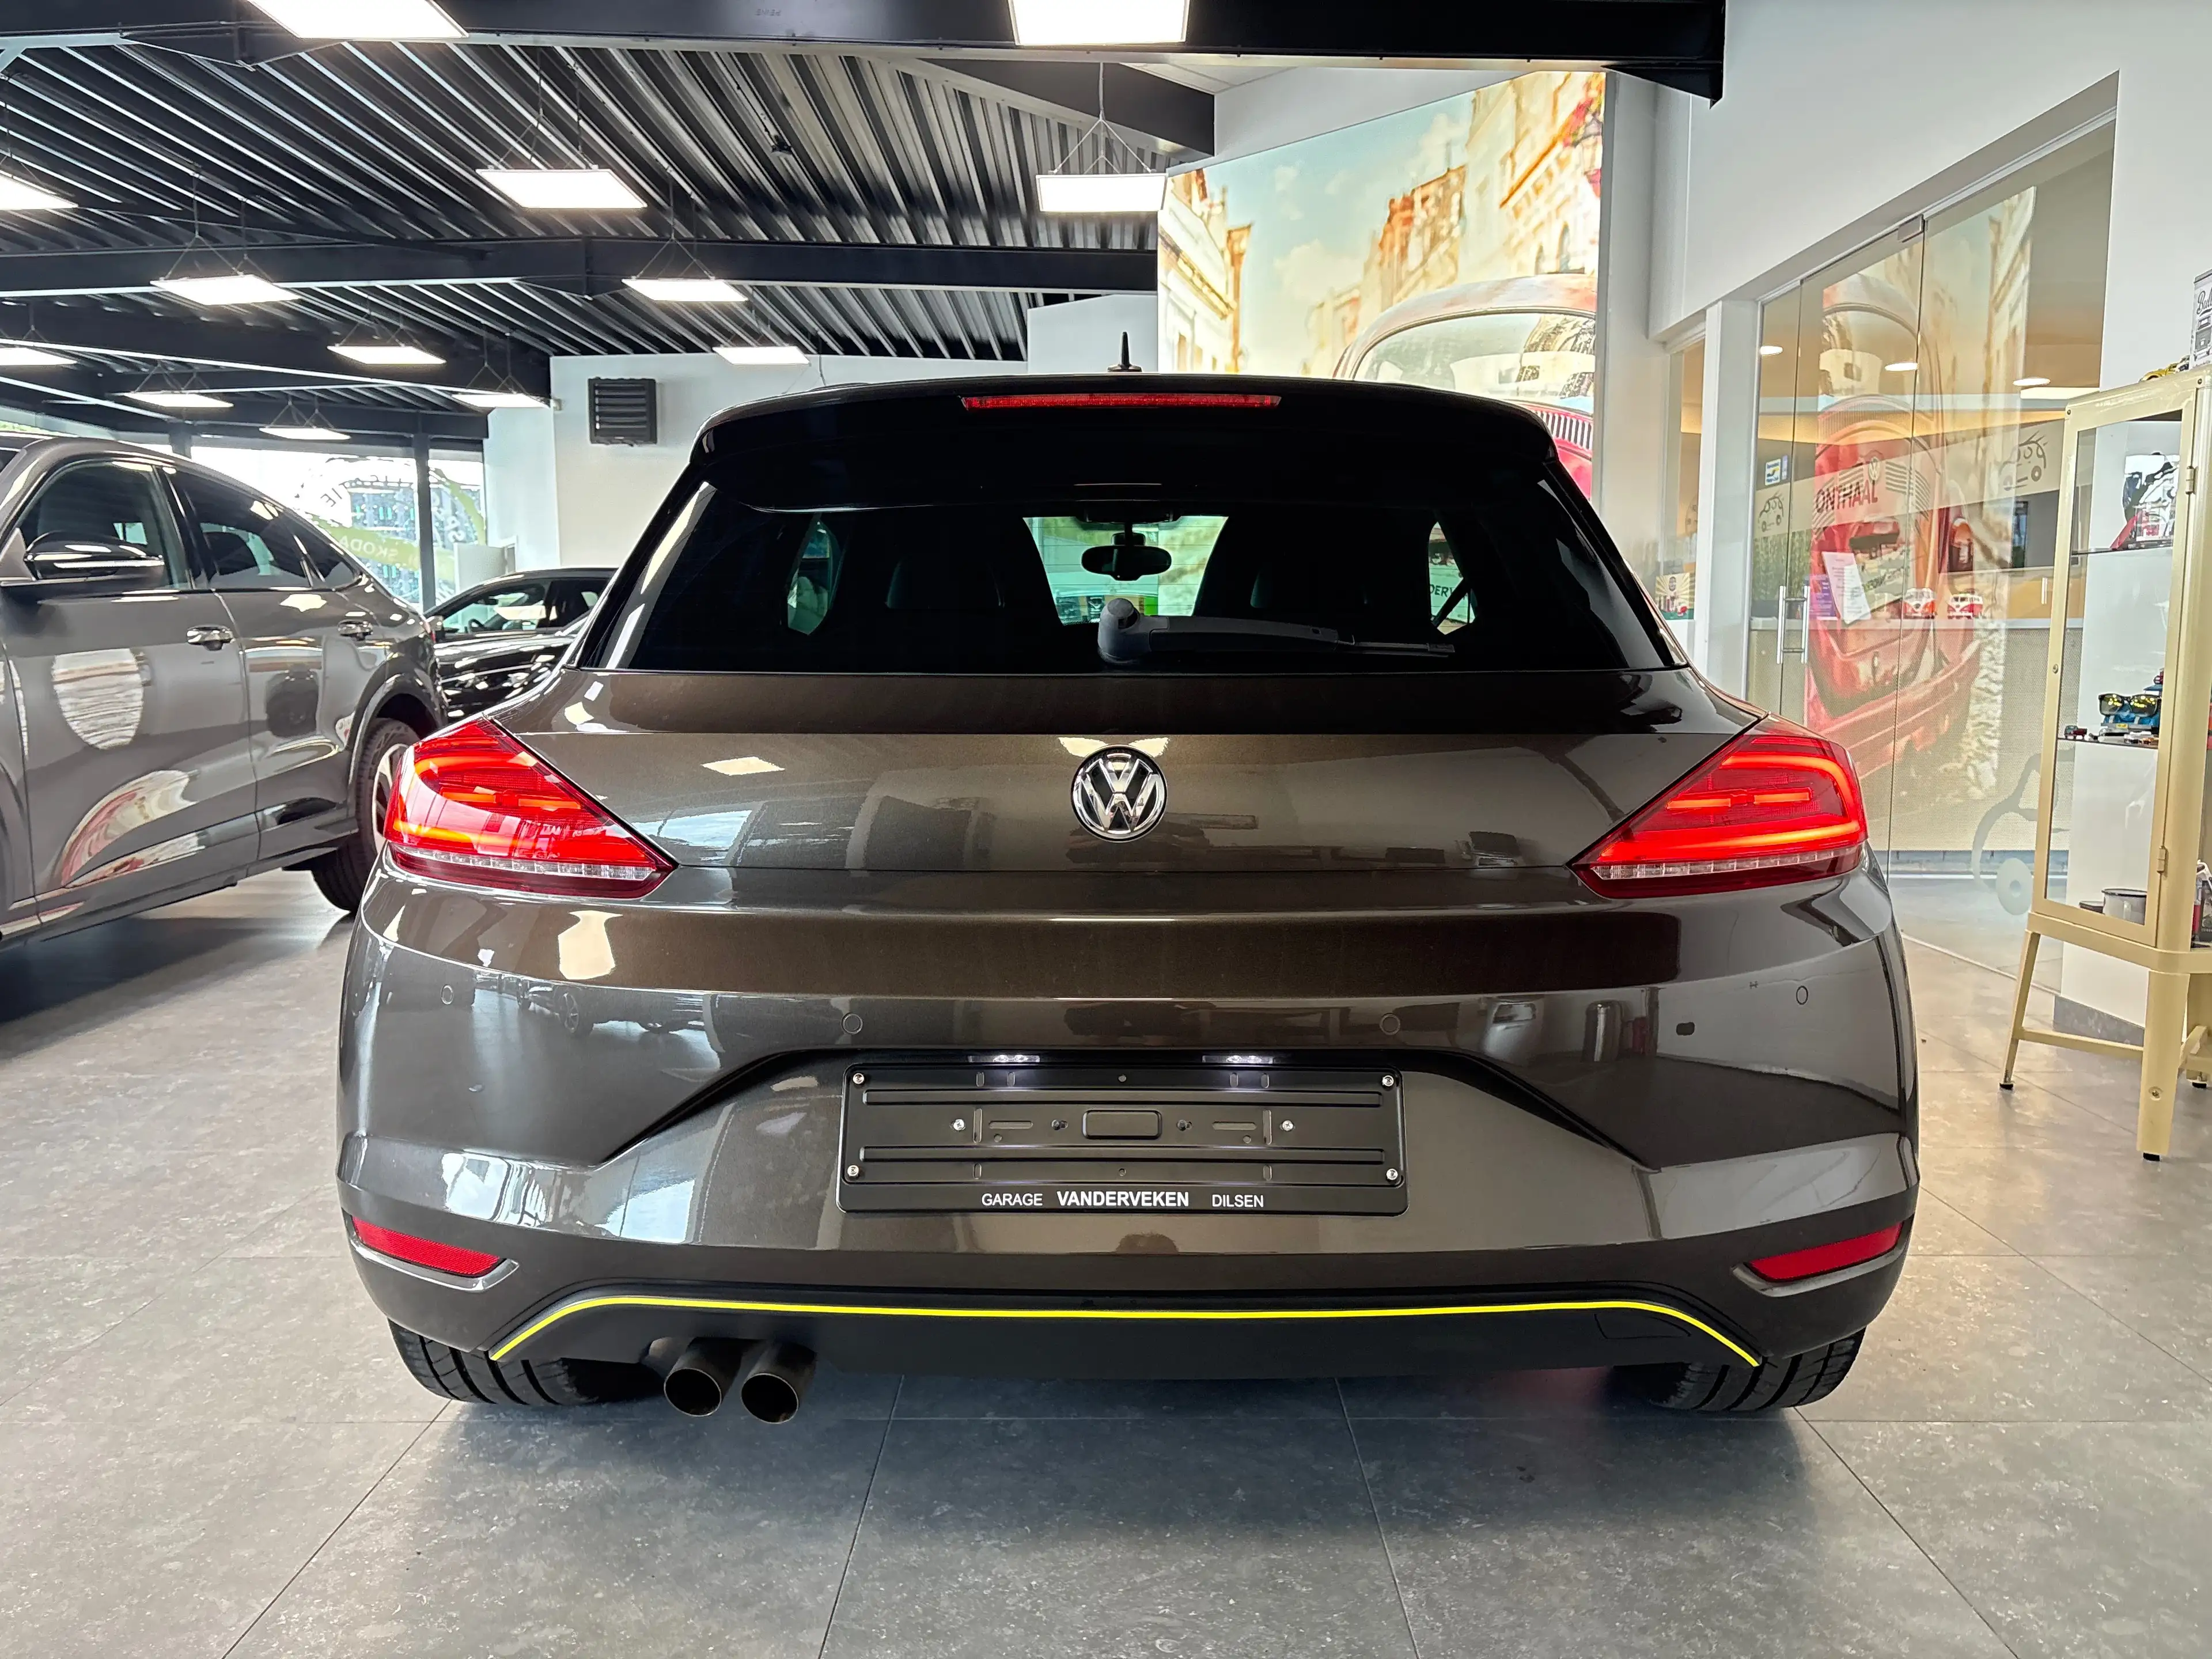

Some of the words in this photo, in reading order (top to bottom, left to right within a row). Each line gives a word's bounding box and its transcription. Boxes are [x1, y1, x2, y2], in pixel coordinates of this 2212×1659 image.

[1815, 479, 1878, 513] ONTHAAL
[982, 1194, 1043, 1206] GARAGE
[1057, 1191, 1188, 1206] VANDERVEKEN
[1213, 1195, 1263, 1207] DILSEN
